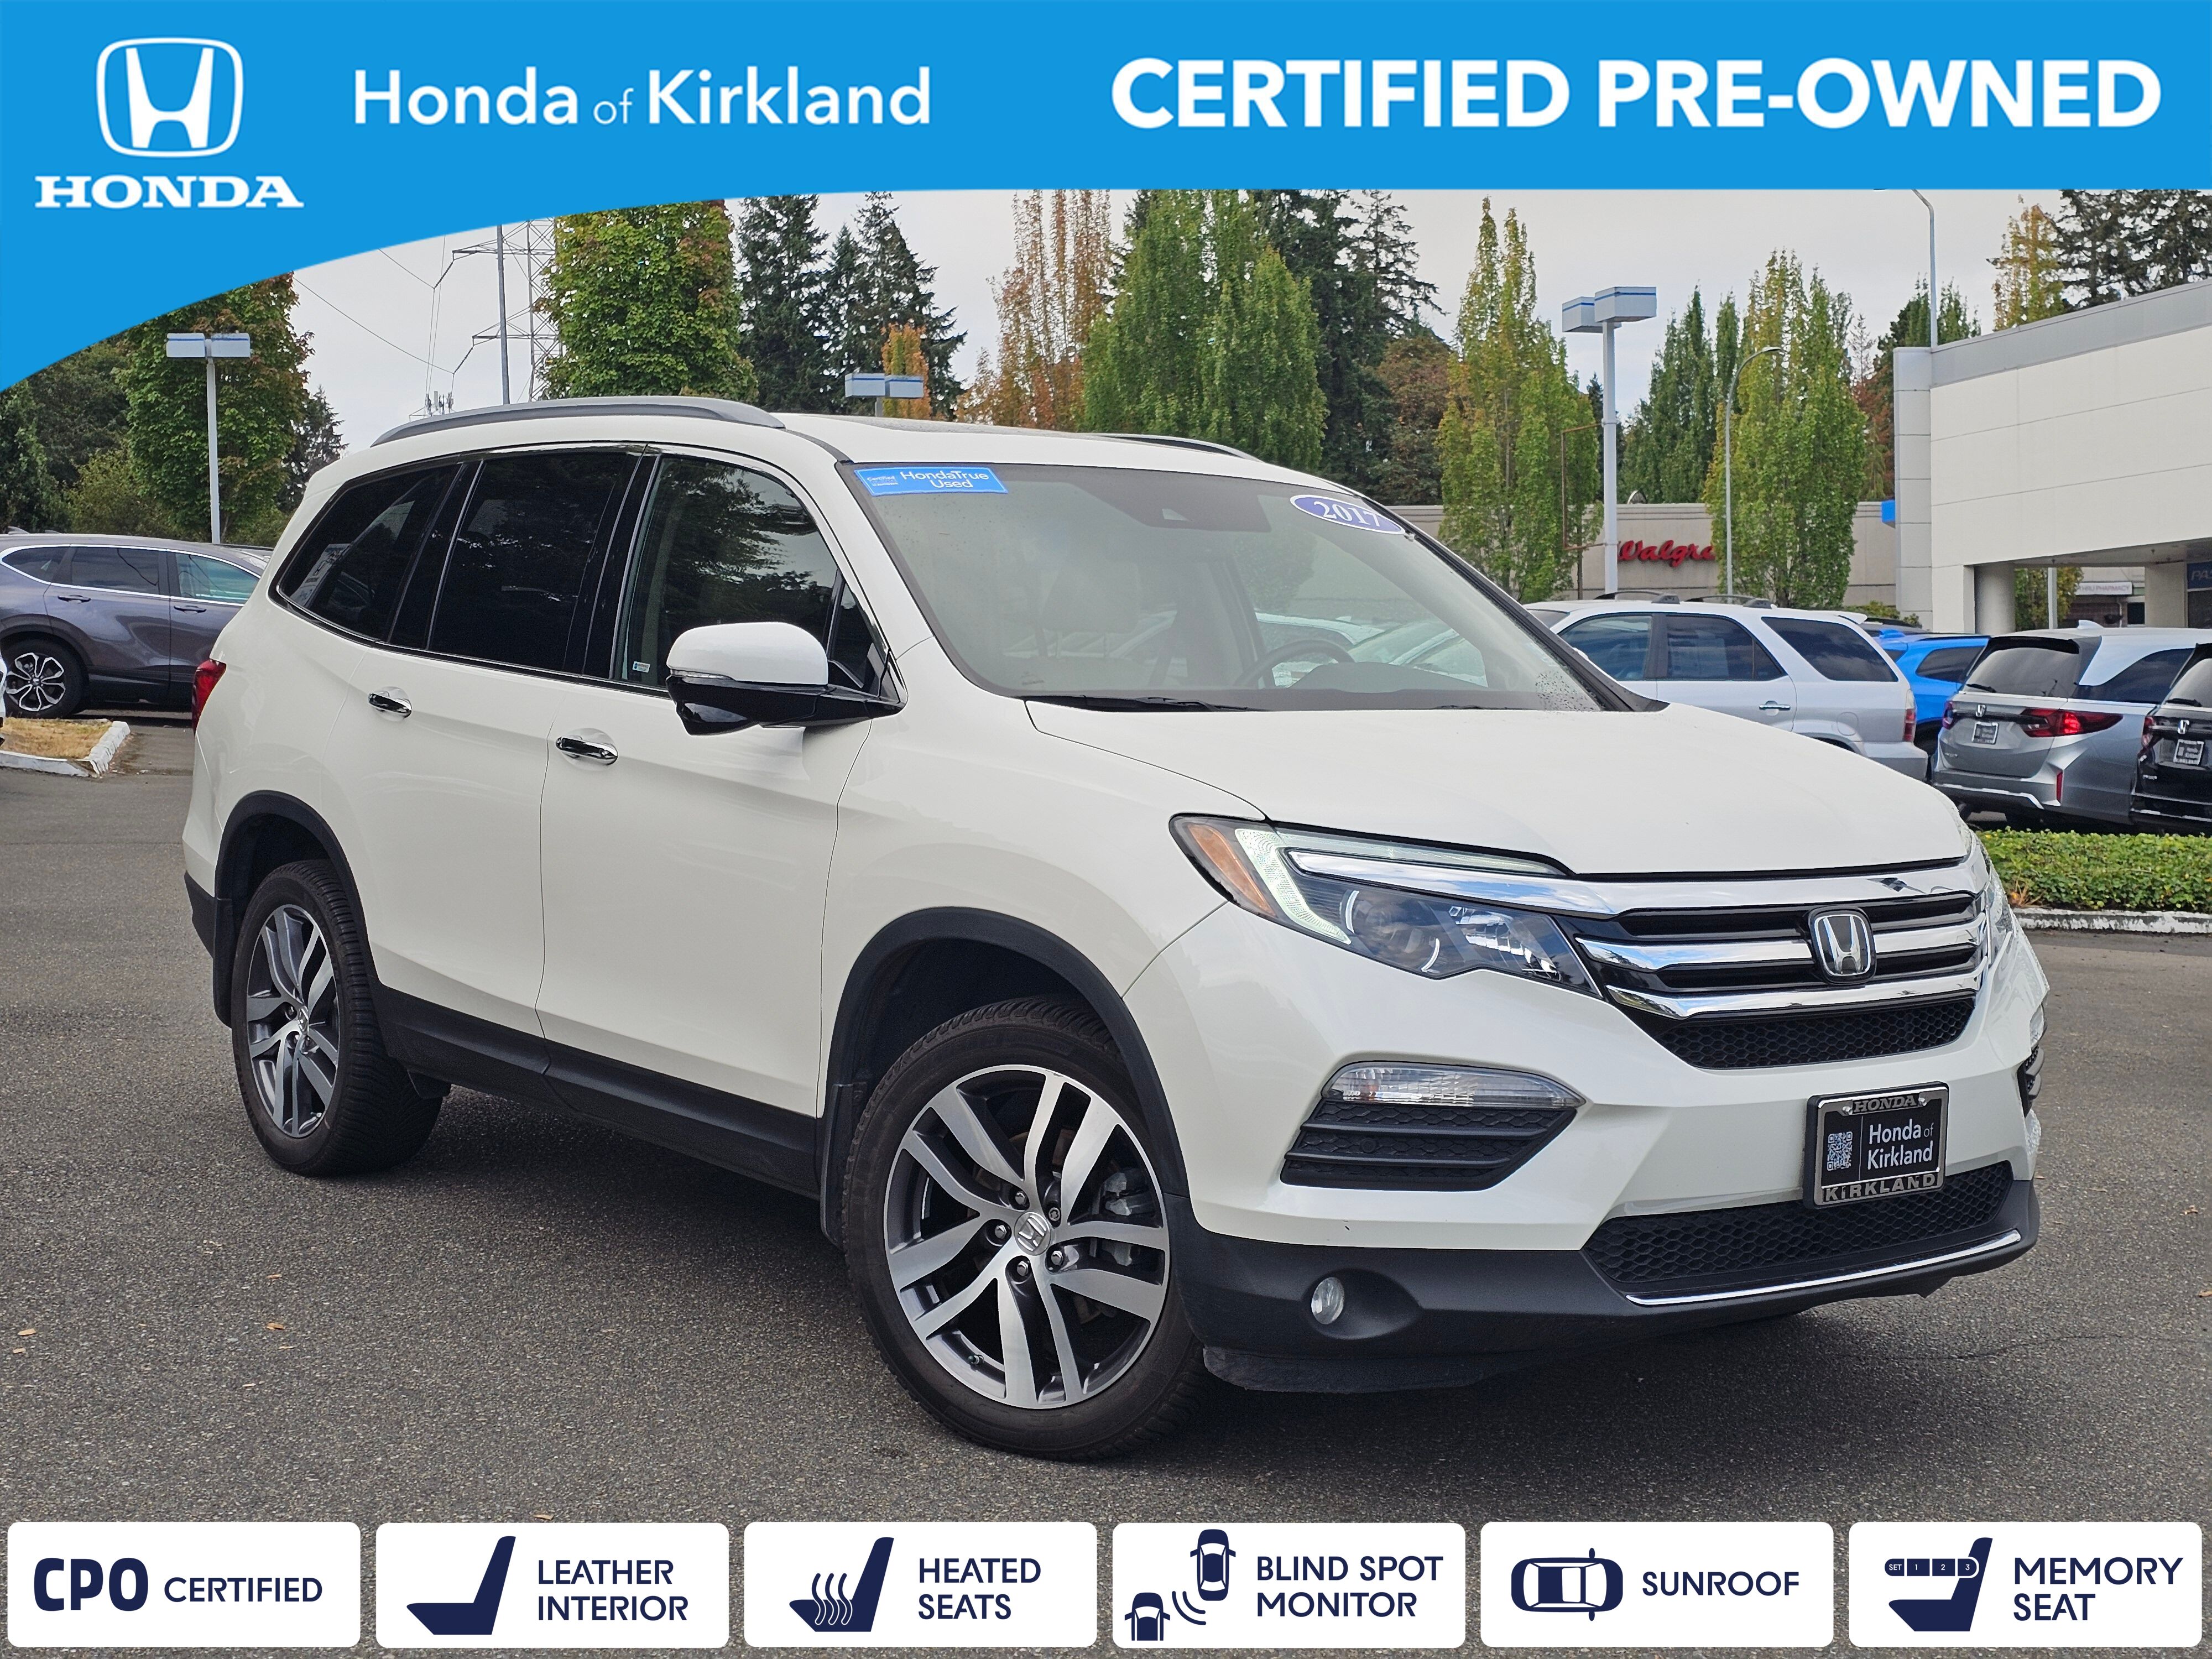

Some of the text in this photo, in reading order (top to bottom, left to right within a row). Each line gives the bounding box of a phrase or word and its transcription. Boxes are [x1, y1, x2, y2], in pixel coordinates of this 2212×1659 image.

[900, 470, 989, 481] HondaTrue
[929, 479, 974, 489] Used
[1313, 500, 1380, 527] 2017
[1853, 1095, 1917, 1113] HONDA
[1869, 1118, 1934, 1145] Honda of
[1867, 1140, 1934, 1170] Kirkland
[1825, 1173, 1936, 1202] KIRKLAND
